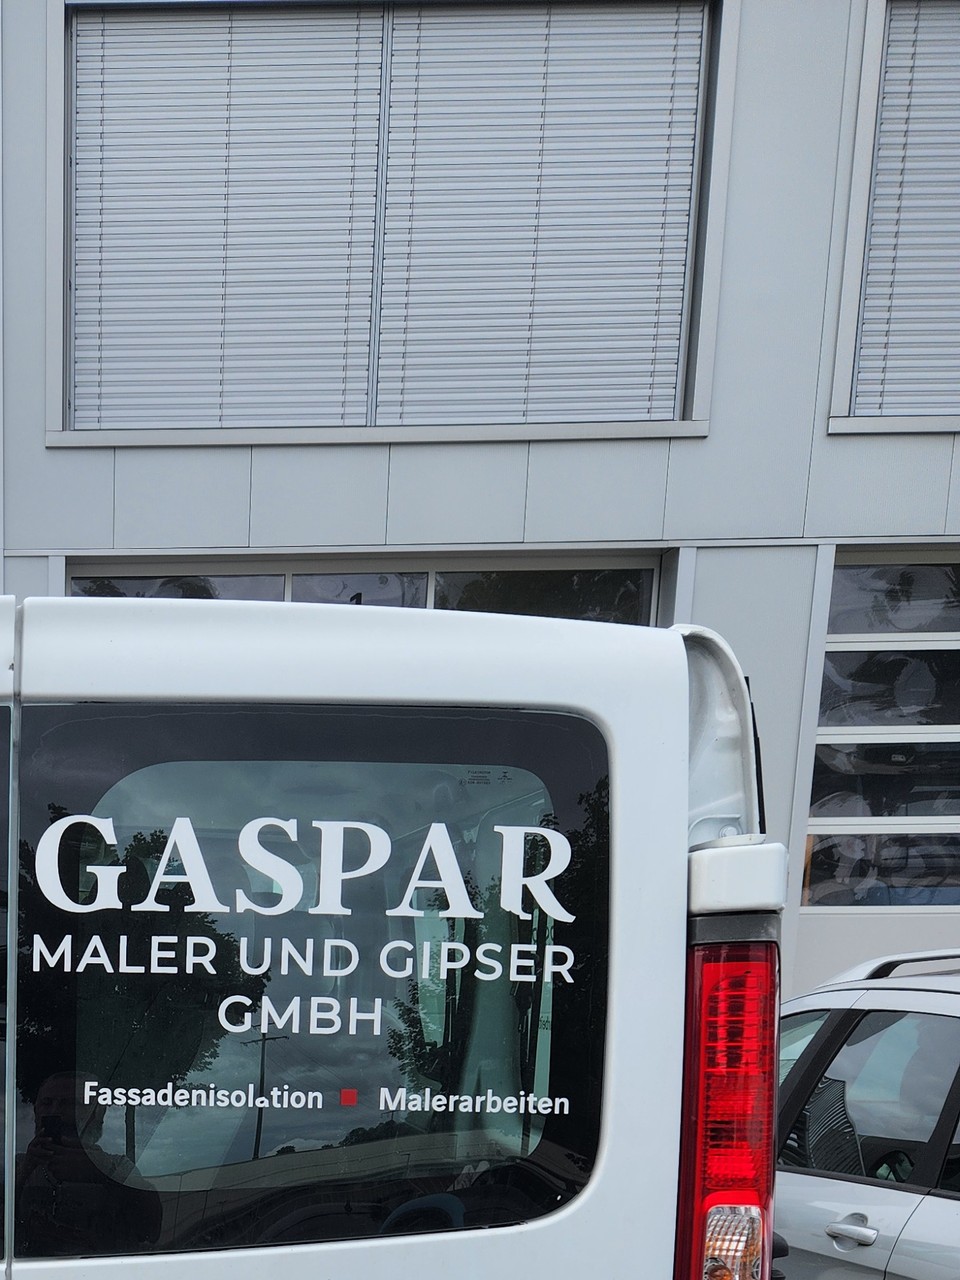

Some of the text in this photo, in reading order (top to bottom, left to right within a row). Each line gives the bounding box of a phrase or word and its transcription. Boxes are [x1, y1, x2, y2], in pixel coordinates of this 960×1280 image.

[34, 814, 577, 923] GASPAR
[32, 934, 576, 984] MALER UND GIPSER
[218, 995, 383, 1036] GMBH
[379, 1087, 570, 1115] Malerarbeiten
